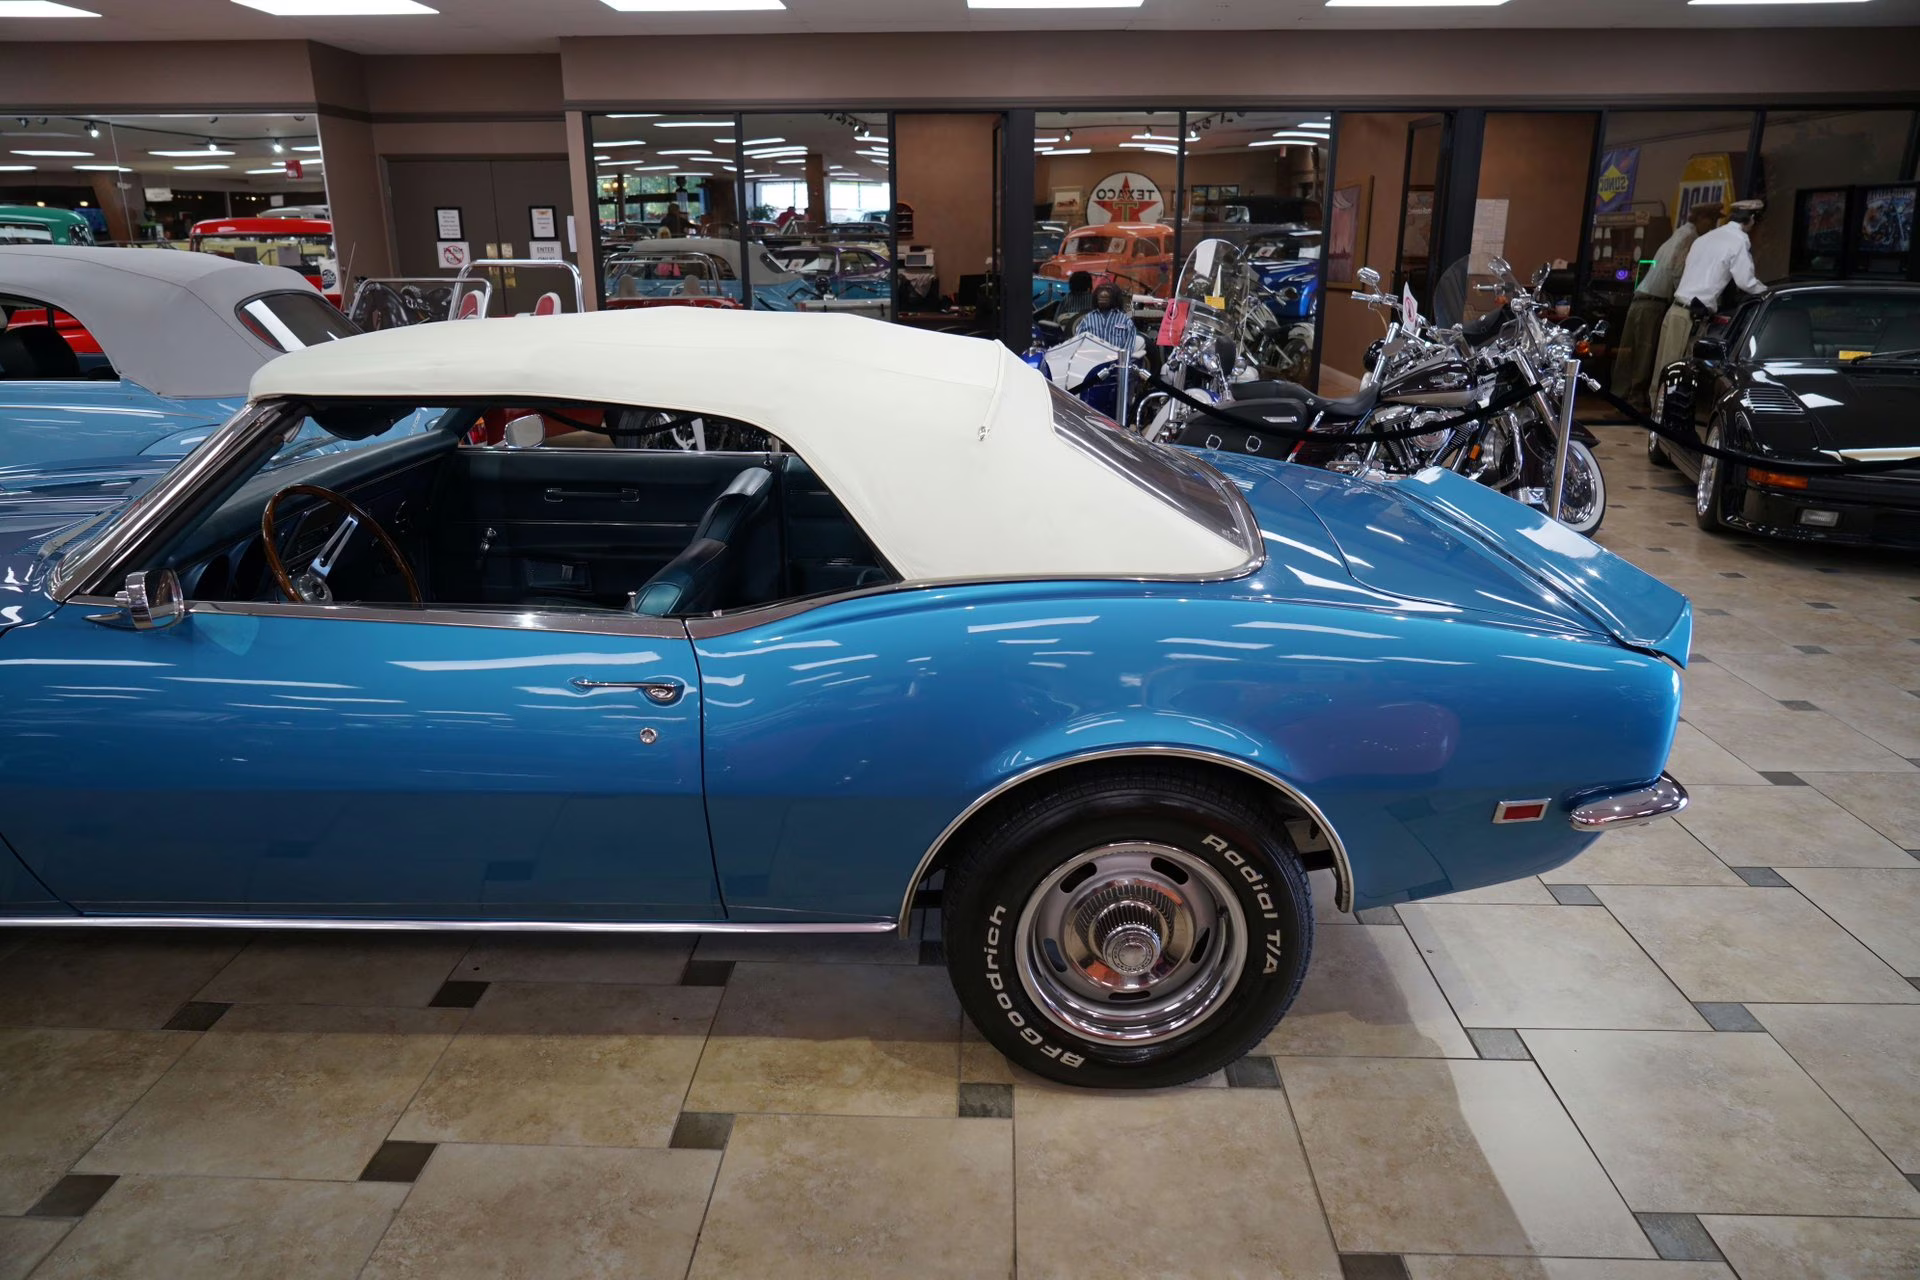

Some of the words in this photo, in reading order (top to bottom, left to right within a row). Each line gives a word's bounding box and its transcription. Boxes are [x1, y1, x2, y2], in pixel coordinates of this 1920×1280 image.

[536, 246, 555, 254] ENTER
[1201, 834, 1279, 919] Radial
[1263, 929, 1281, 975] T/A
[984, 904, 1086, 1068] BFGoodrich
